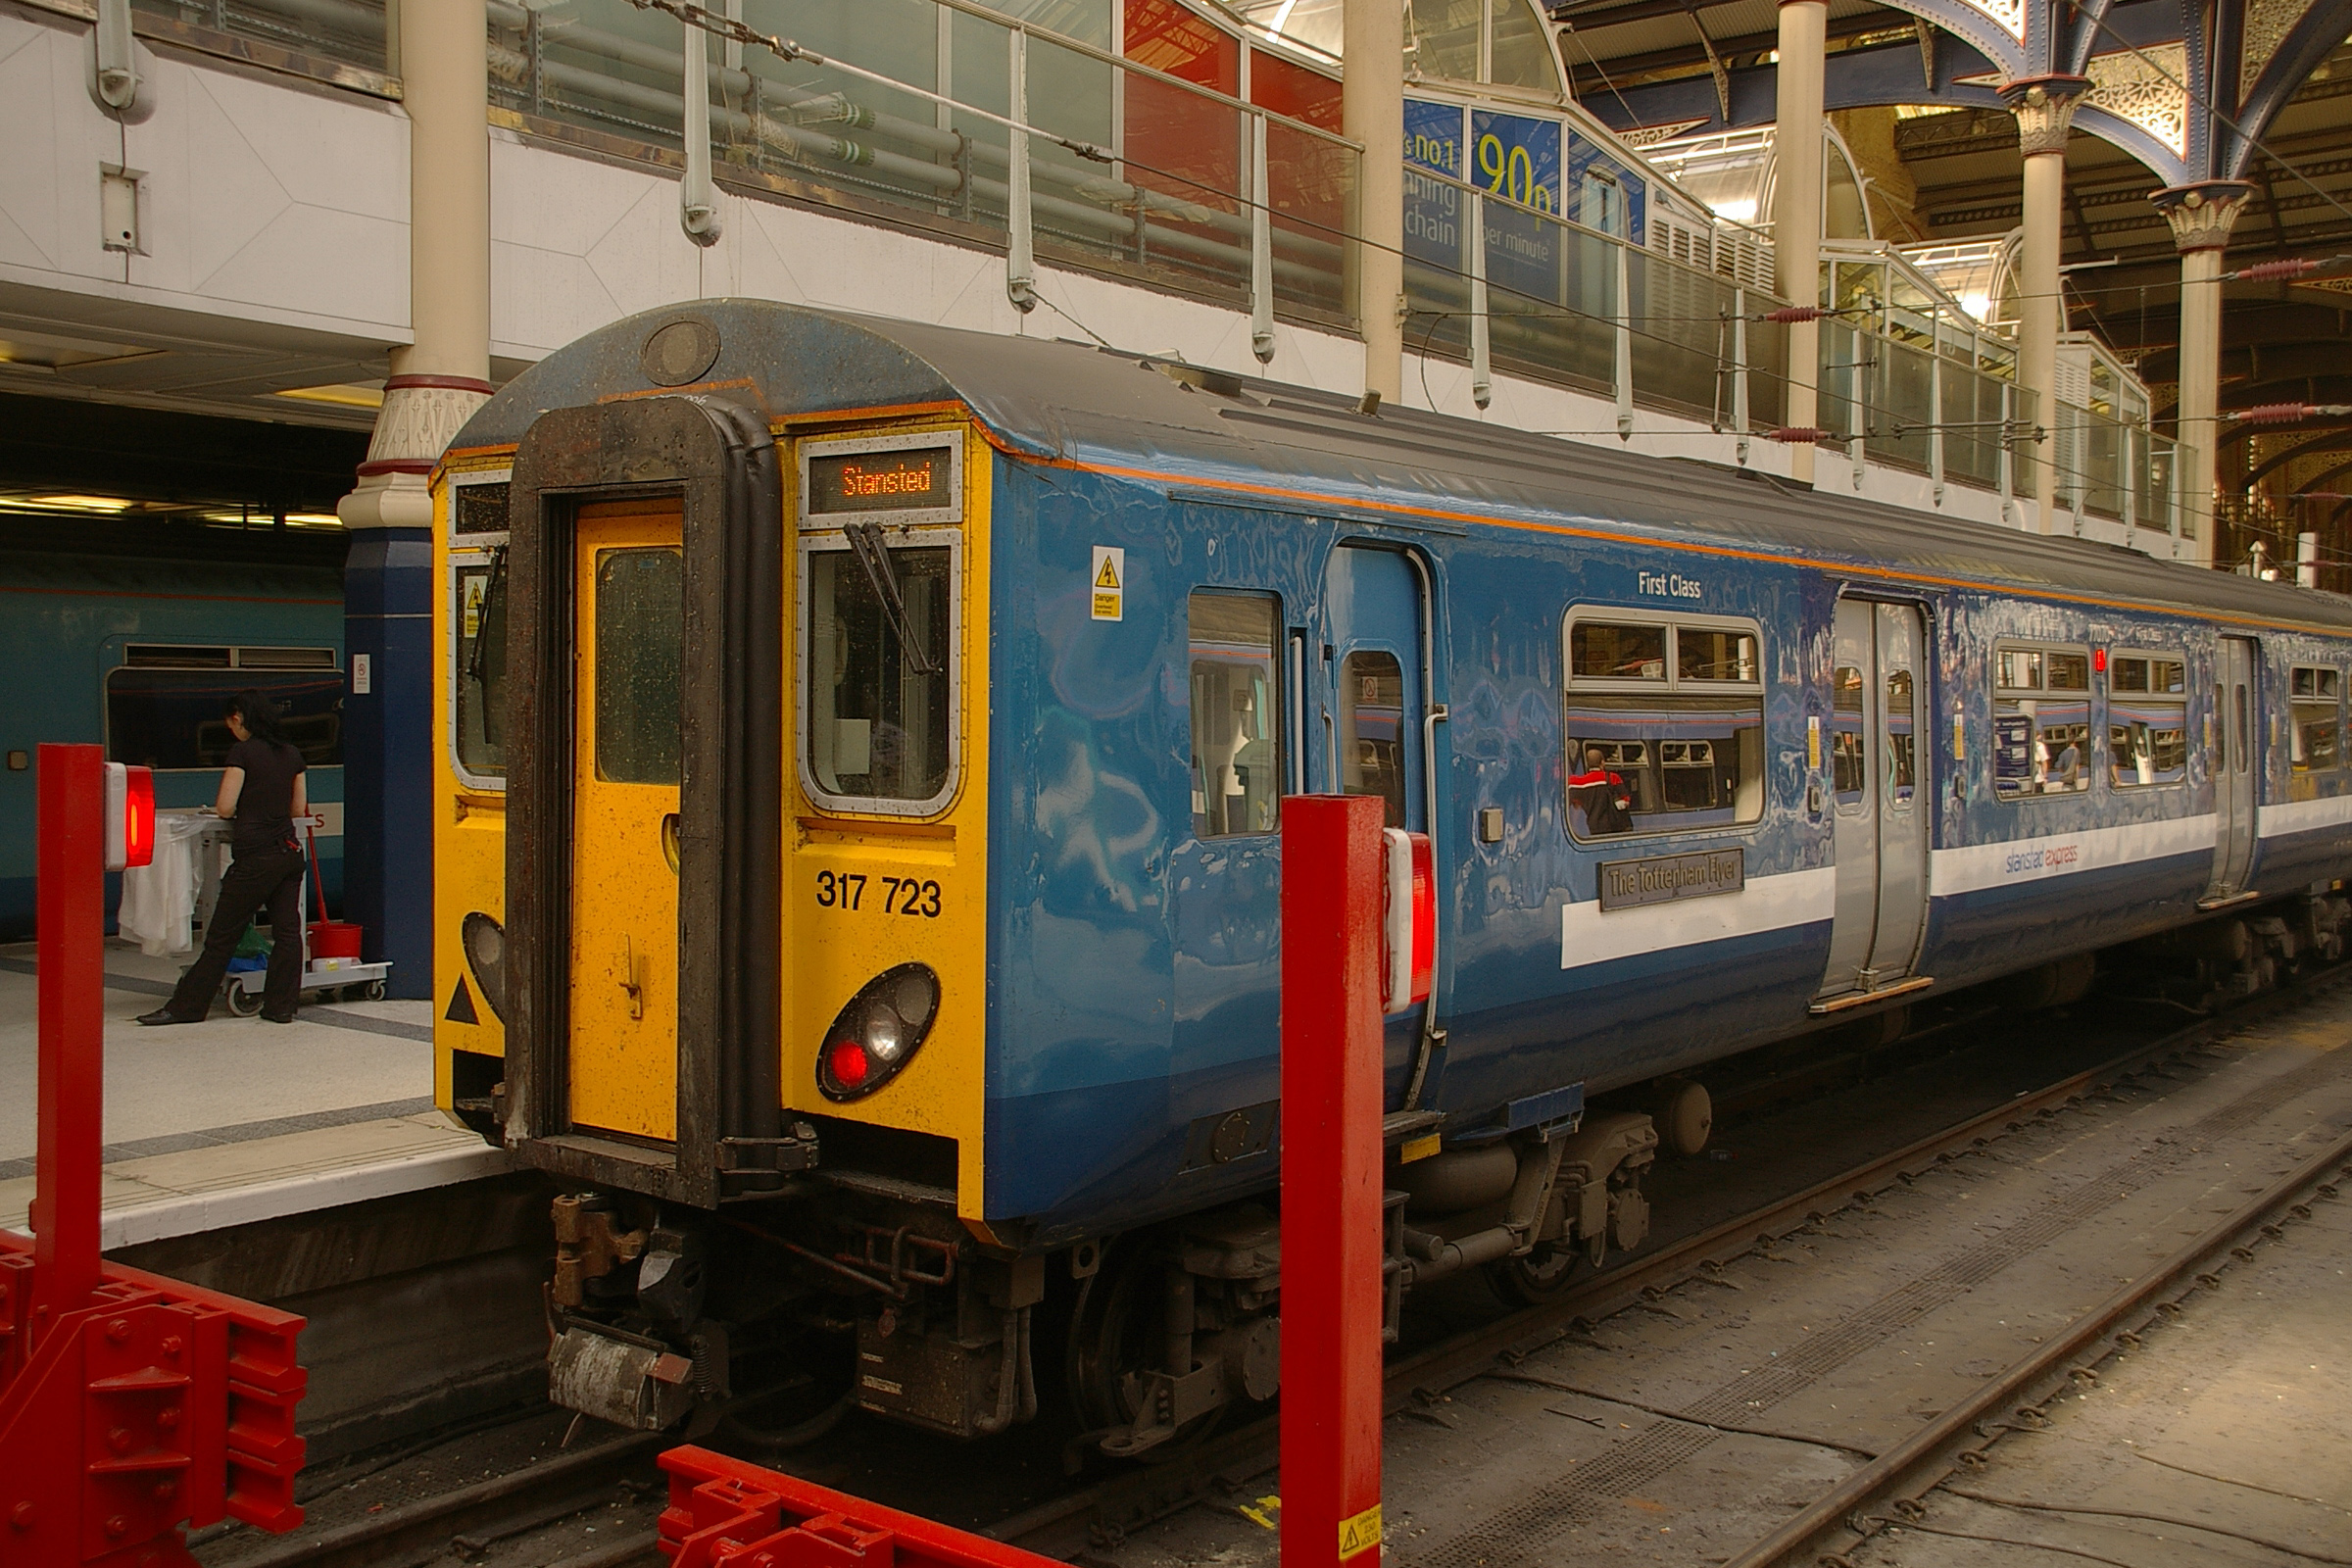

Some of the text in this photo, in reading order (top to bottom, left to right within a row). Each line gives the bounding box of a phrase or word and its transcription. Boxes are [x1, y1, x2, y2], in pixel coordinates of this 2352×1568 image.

[1415, 134, 1453, 171] no.1
[1479, 133, 1550, 231] 90p
[1404, 204, 1455, 247] chain
[1505, 233, 1548, 262] minute
[843, 461, 931, 496] Stansted
[1639, 571, 1701, 599] First Class
[1609, 856, 1736, 897] The Tottenham Flyer
[2005, 844, 2078, 874] stansted express
[816, 870, 941, 918] 317 723
